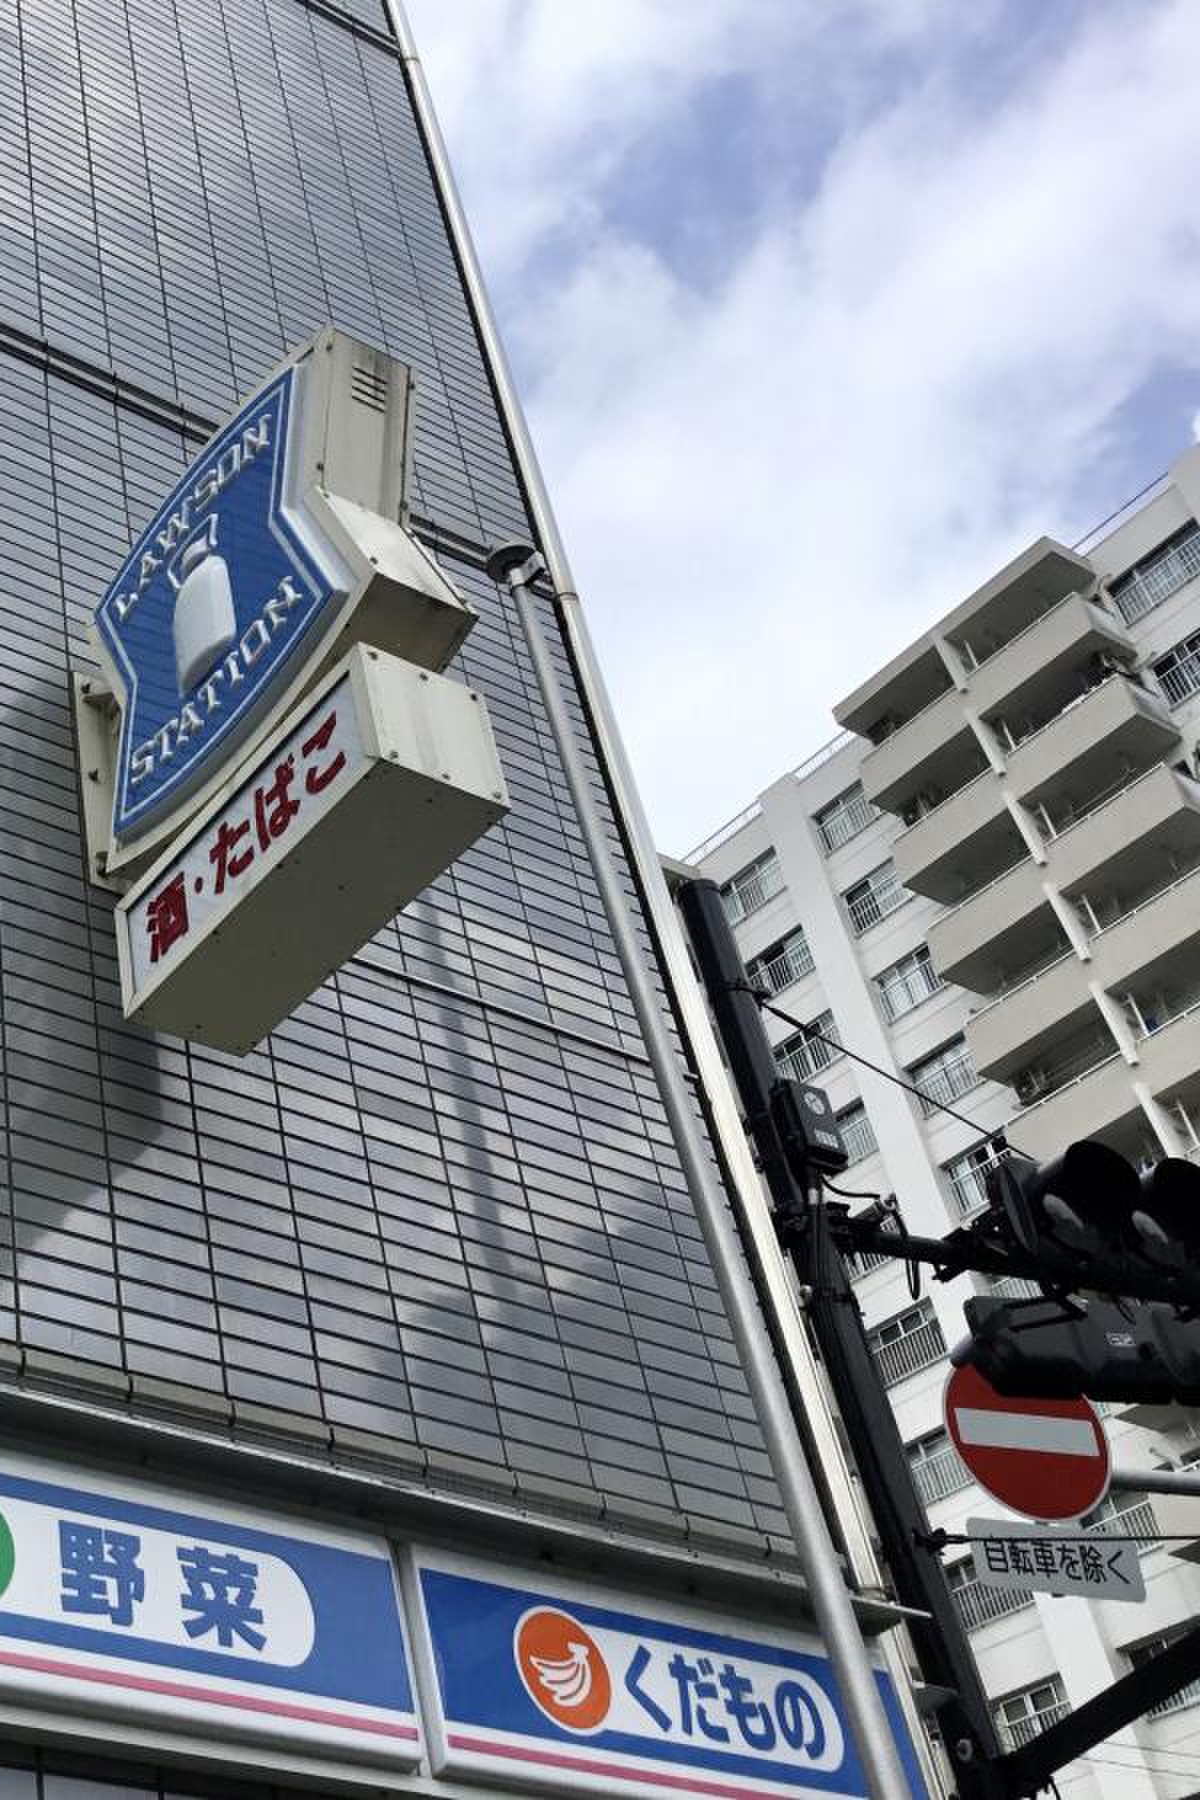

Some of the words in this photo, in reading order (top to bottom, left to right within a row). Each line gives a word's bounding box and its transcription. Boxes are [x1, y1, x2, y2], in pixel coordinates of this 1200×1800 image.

[115, 414, 273, 622] LAWSON
[131, 575, 303, 785] STATION
[58, 1519, 267, 1652] 野菜
[983, 1536, 1132, 1585] 自転車を除く
[625, 1644, 826, 1761] くだもの
